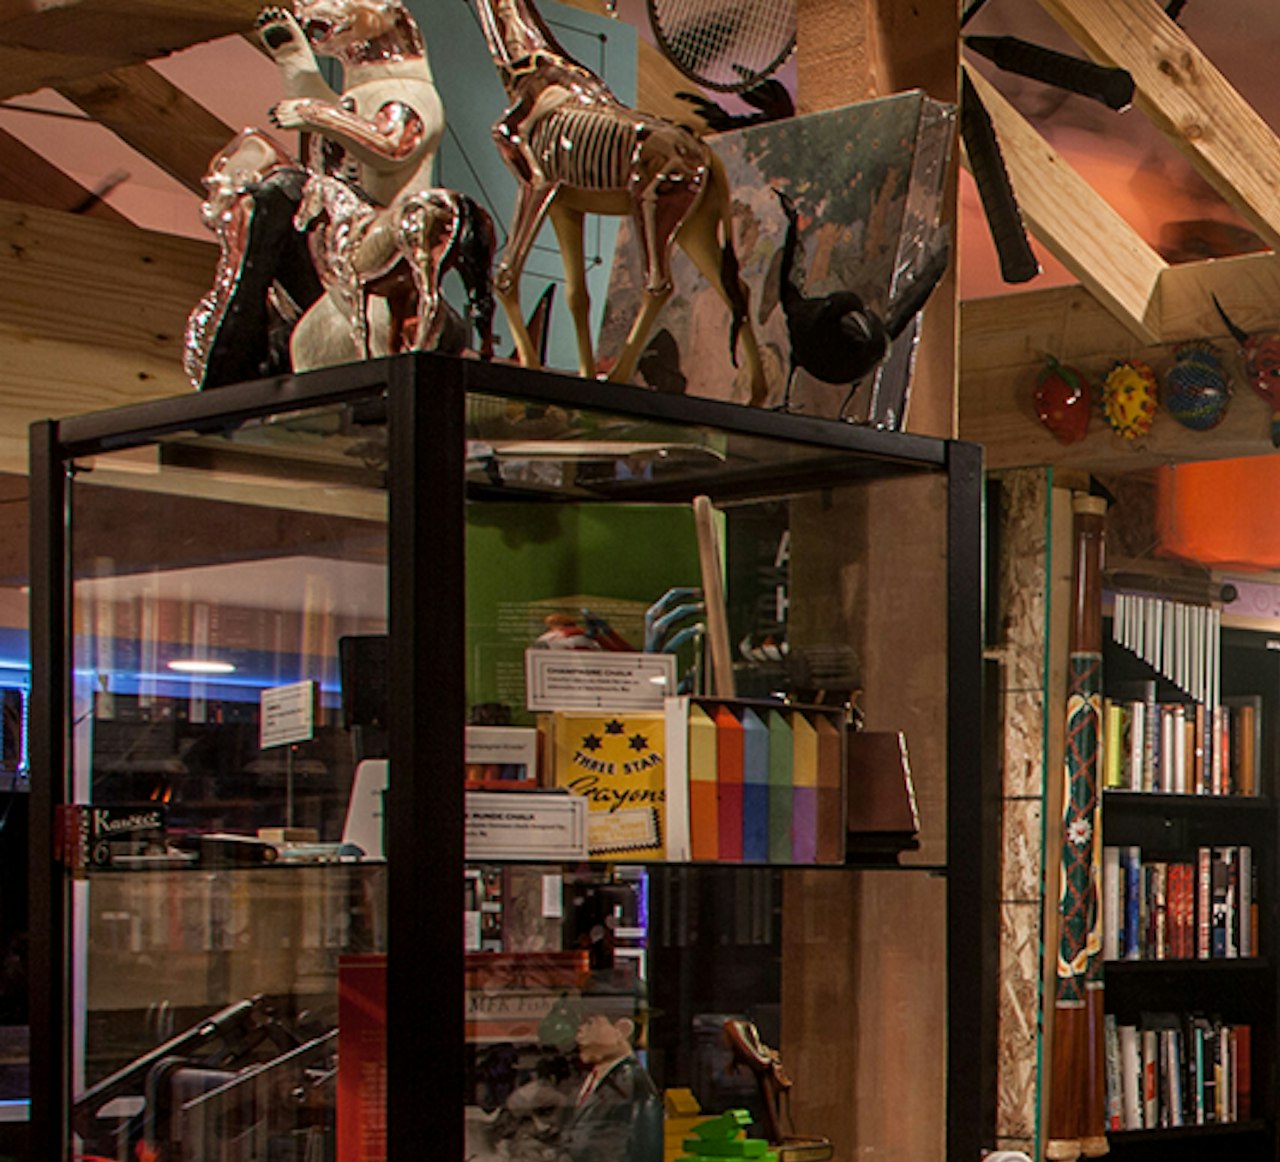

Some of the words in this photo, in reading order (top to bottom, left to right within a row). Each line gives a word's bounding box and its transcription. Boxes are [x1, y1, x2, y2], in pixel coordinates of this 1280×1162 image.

[573, 751, 616, 775] THREE
[624, 752, 662, 774] STAR
[568, 775, 667, 814] Crayons
